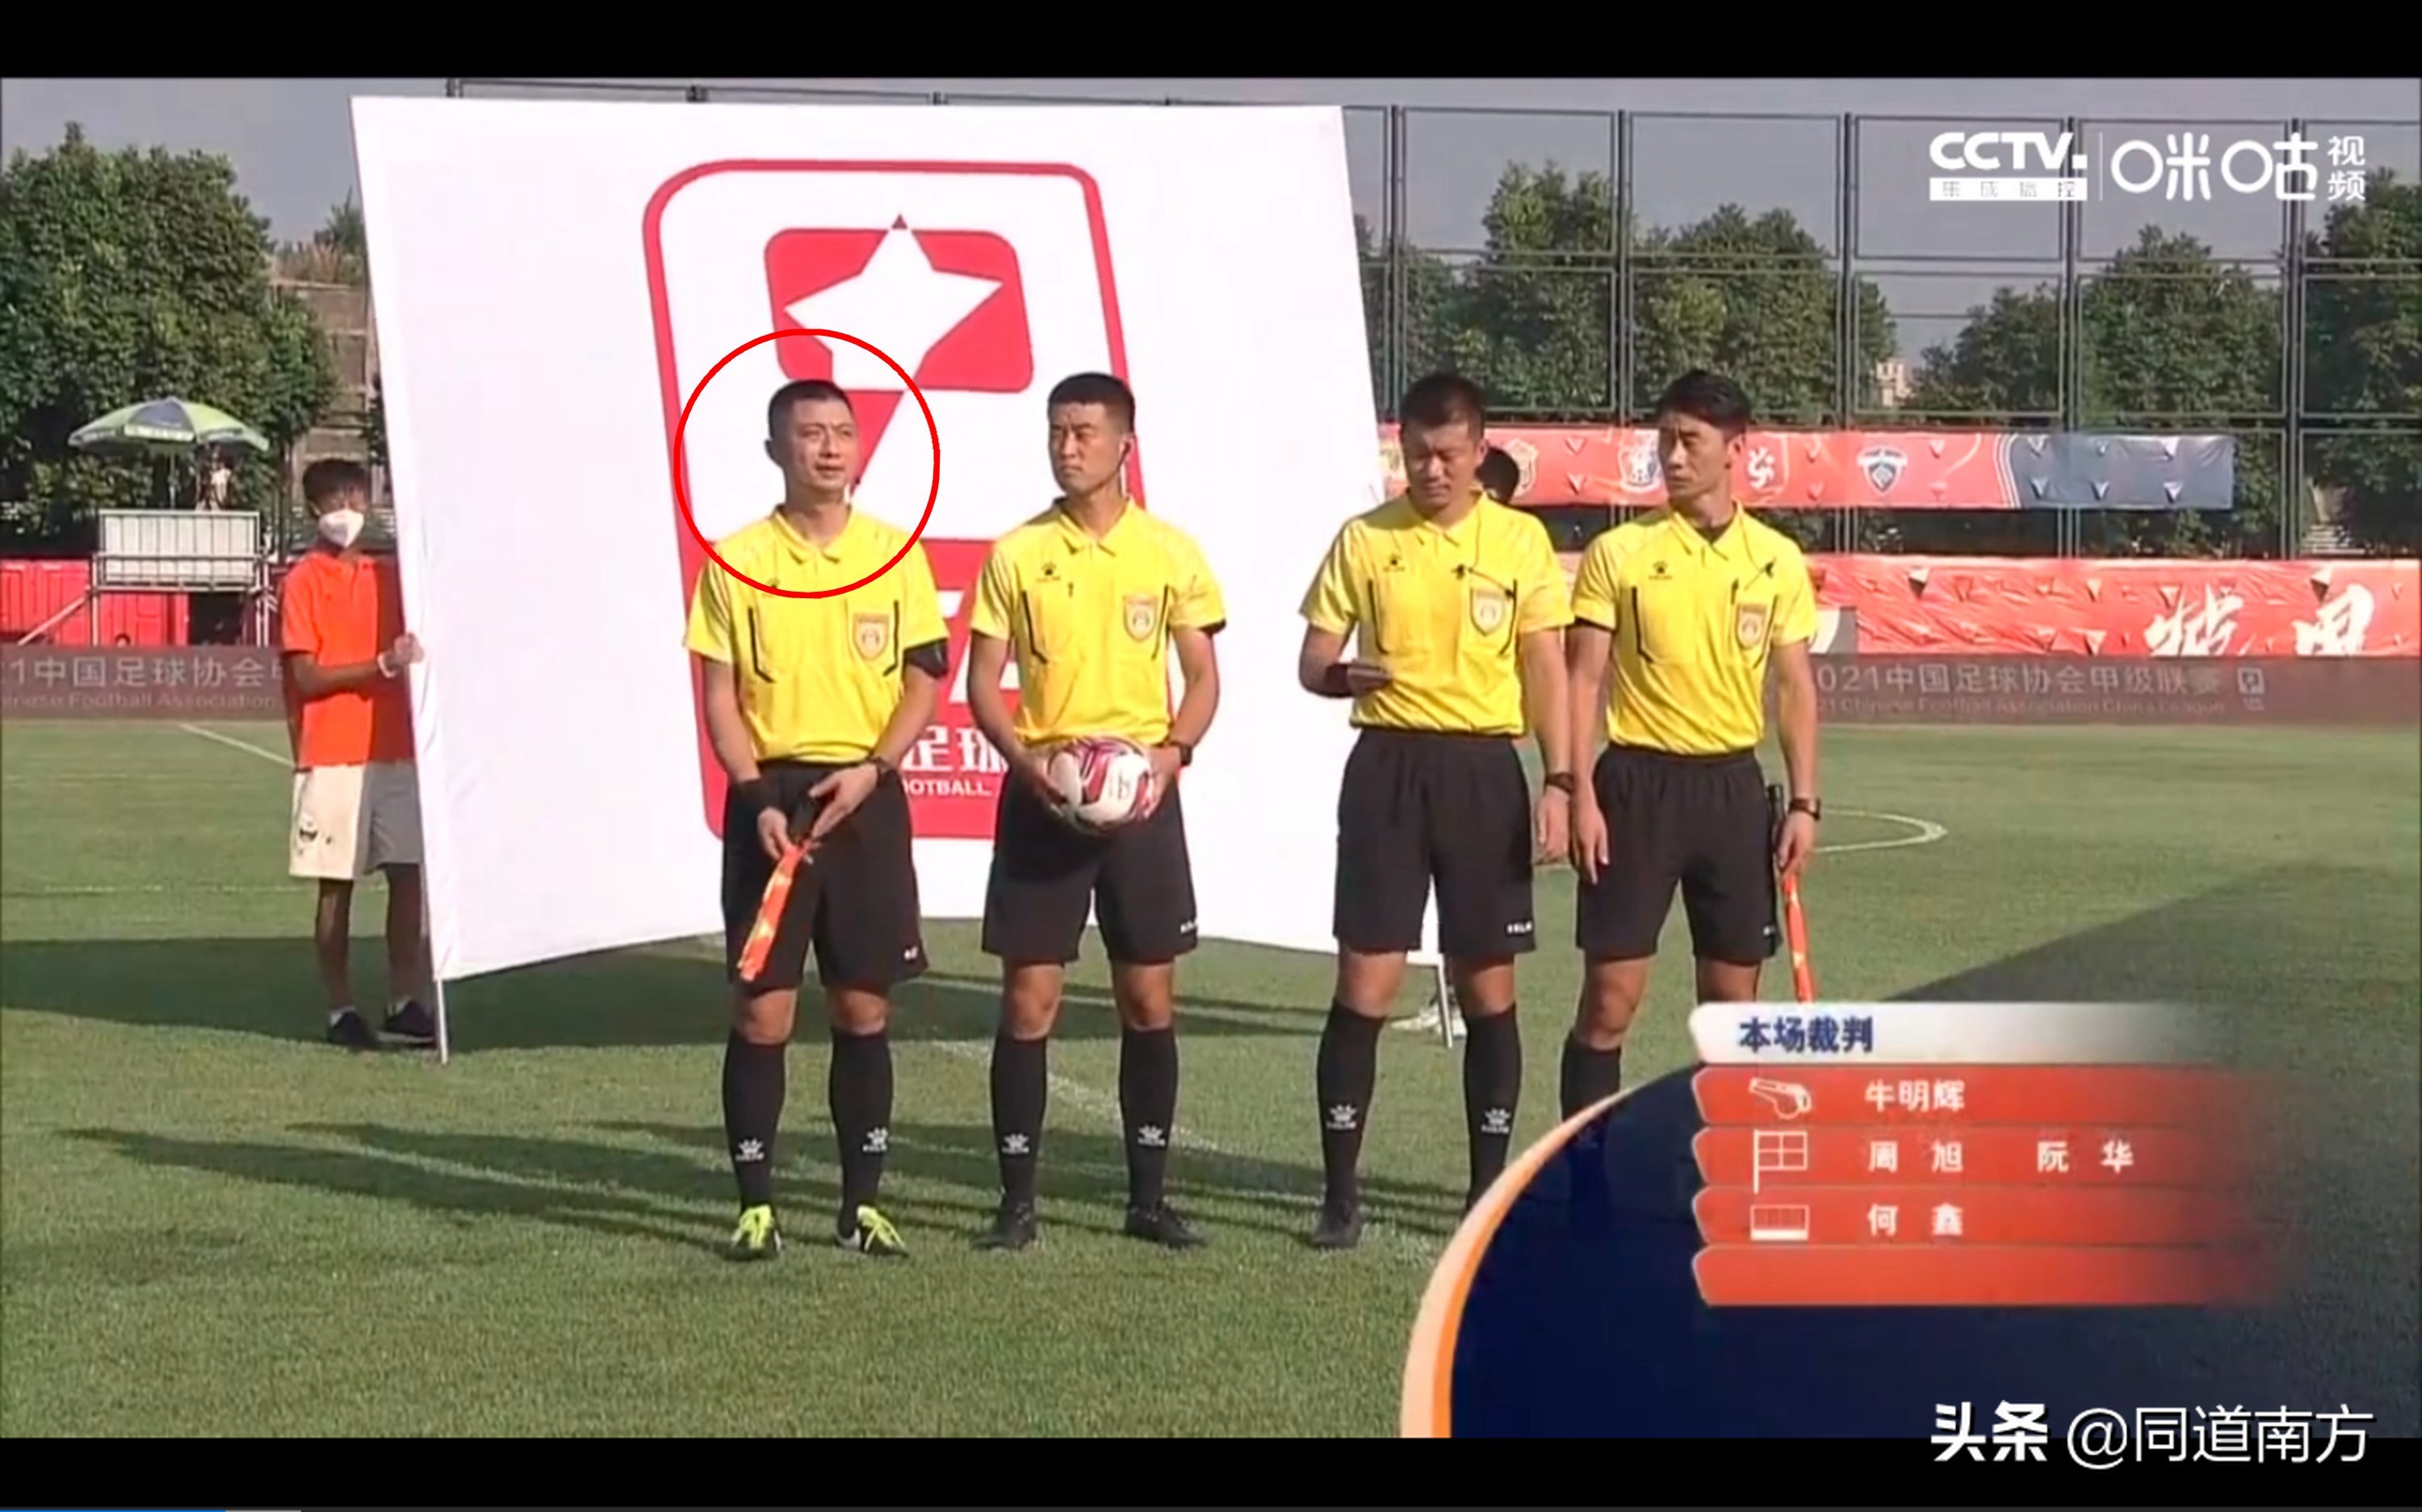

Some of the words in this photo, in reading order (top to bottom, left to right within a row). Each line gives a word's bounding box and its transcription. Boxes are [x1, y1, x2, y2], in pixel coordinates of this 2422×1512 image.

[2, 655, 283, 687] 1中国足球协会
